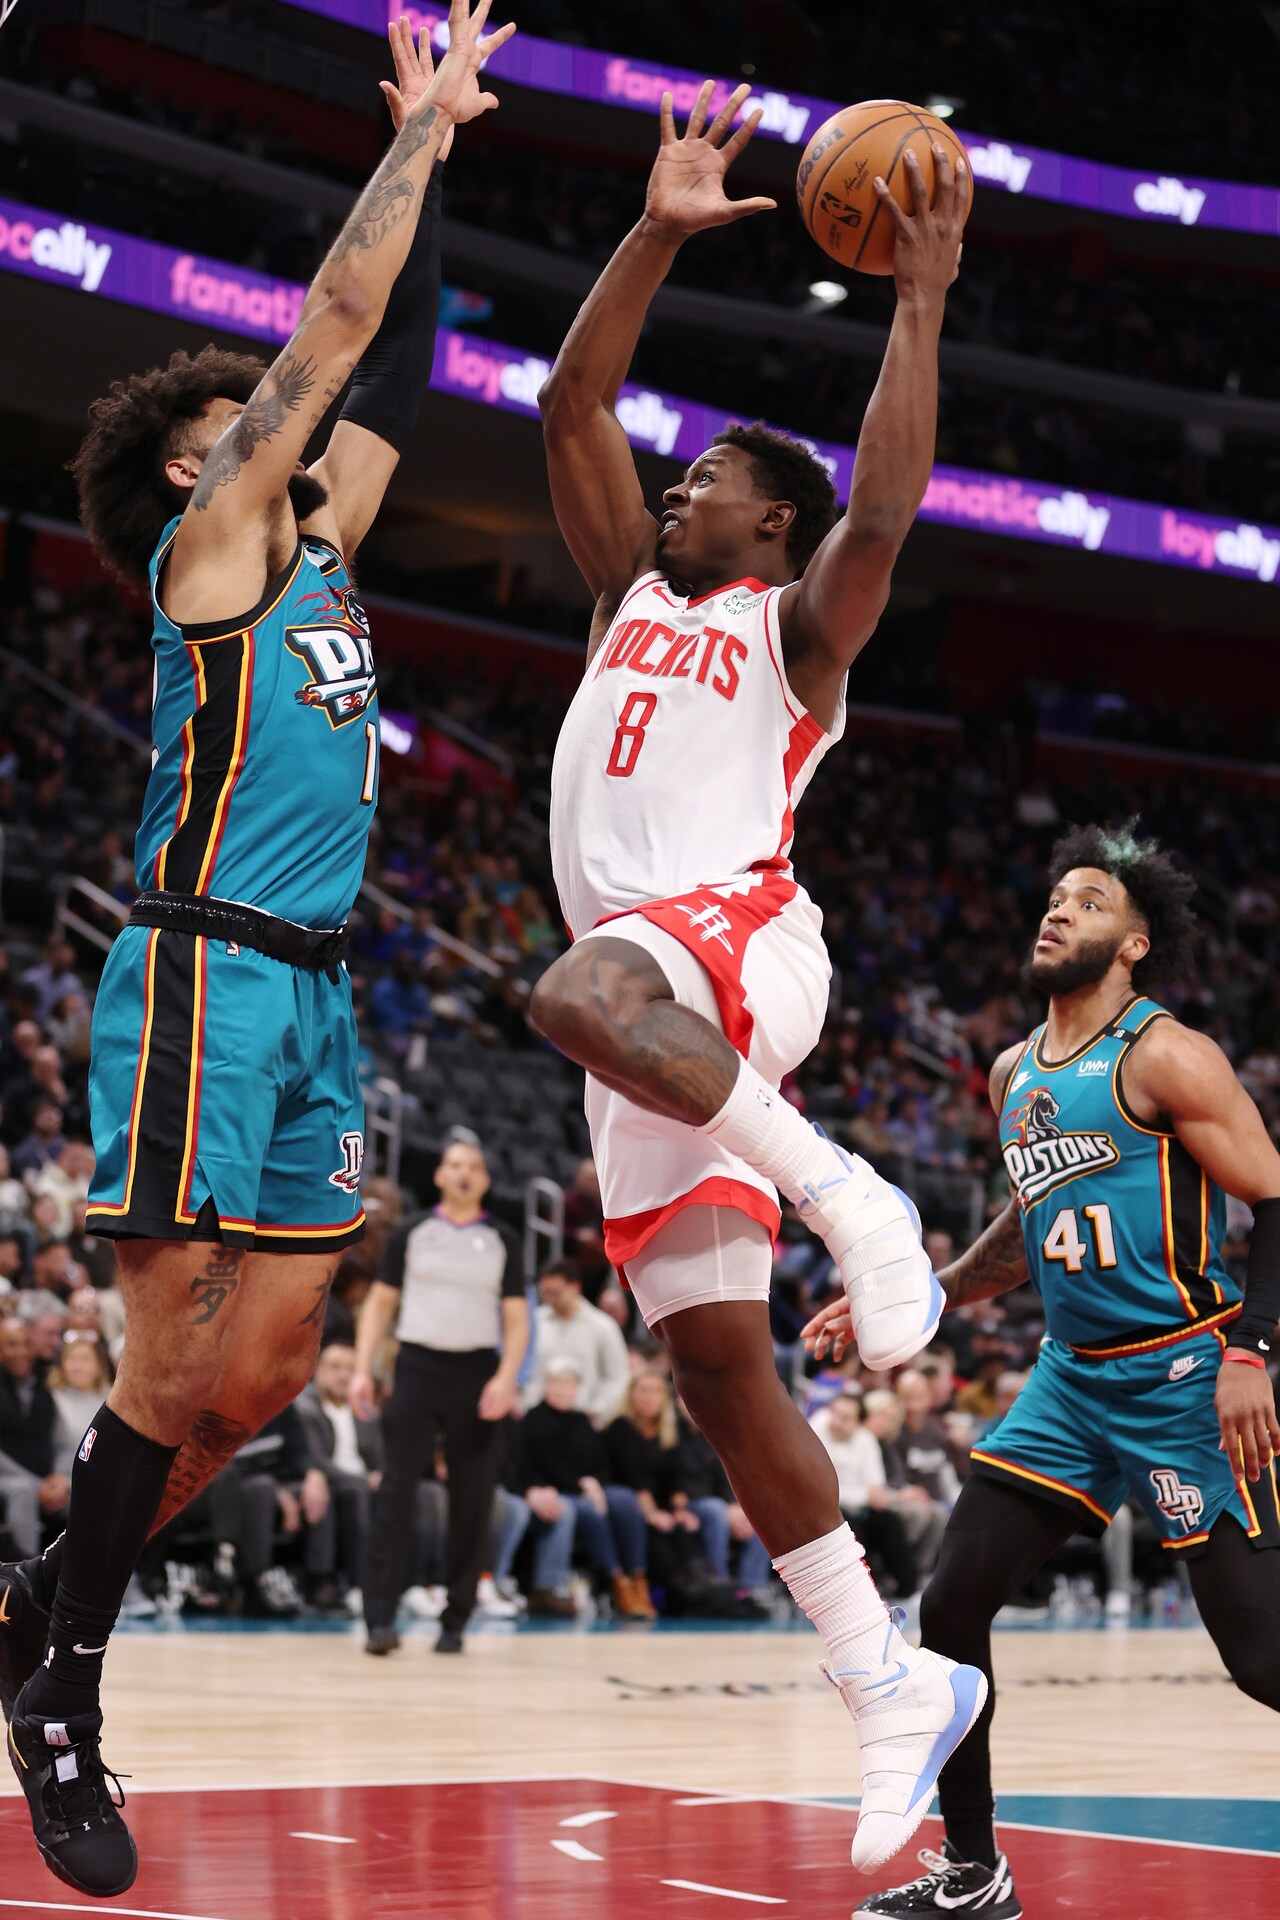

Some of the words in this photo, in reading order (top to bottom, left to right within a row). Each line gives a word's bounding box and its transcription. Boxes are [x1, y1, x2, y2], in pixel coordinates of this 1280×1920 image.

[966, 142, 1032, 193] ally
[1133, 177, 1206, 225] ally
[360, 720, 380, 805] 1
[606, 691, 657, 778] 8
[1078, 1060, 1110, 1073] UWM
[1002, 1135, 1117, 1200] PISTONS
[1042, 1203, 1118, 1273] 41
